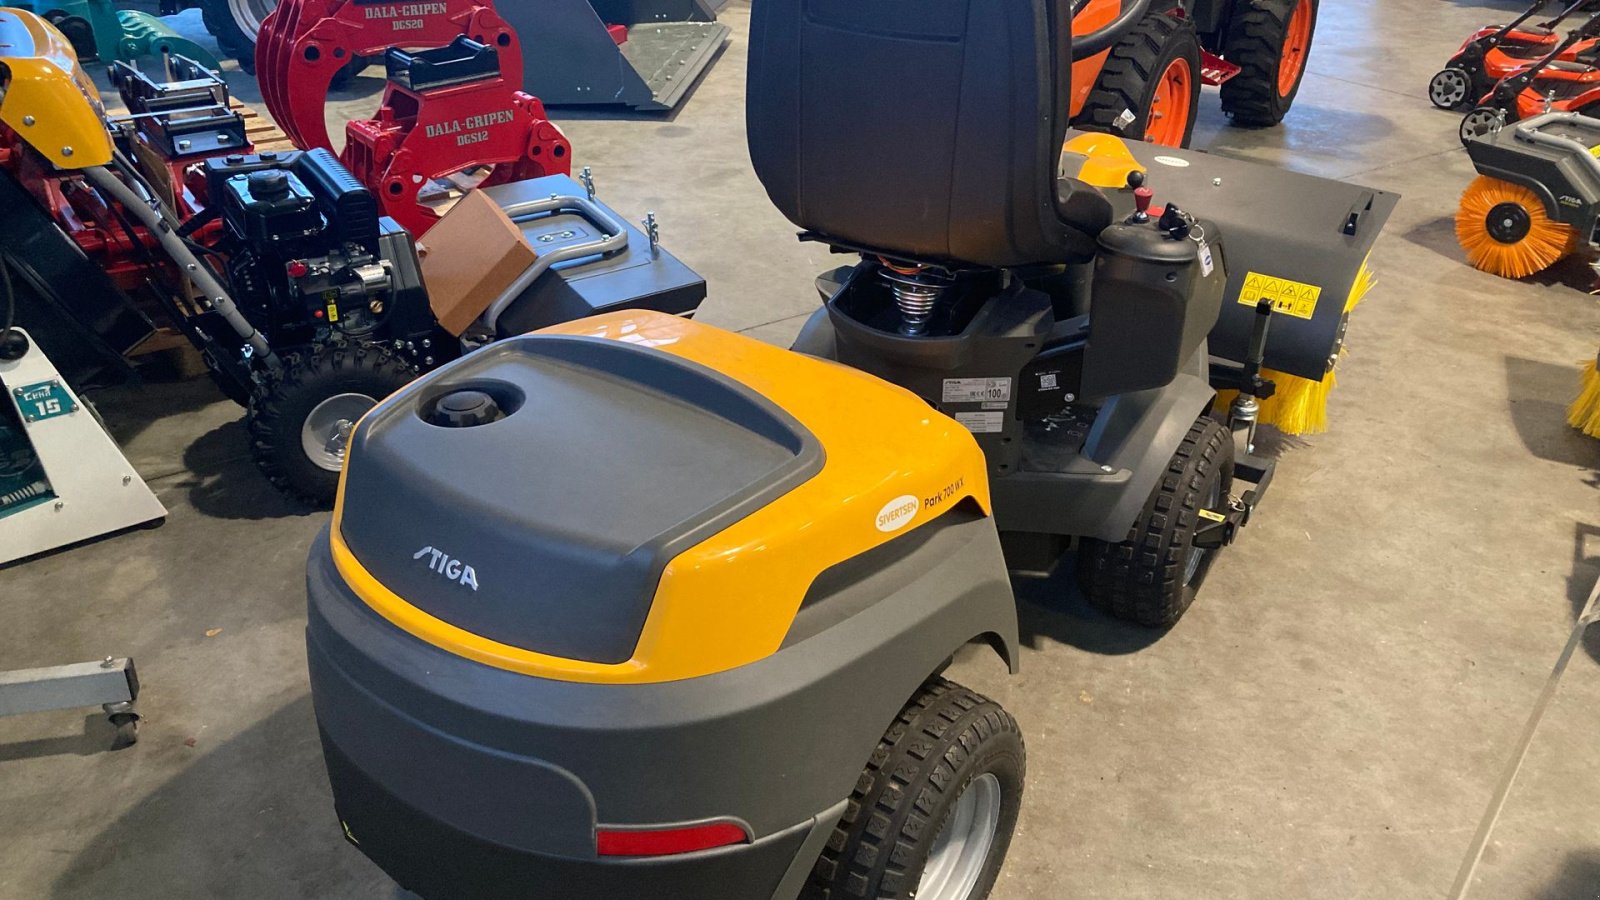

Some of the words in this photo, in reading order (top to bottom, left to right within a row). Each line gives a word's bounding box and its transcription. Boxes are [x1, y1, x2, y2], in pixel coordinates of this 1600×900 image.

[365, 3, 447, 19] DALA-GRIPEN
[392, 19, 424, 31] DGS20
[425, 110, 514, 138] DALA-GRIPEN
[457, 131, 489, 146] DGS12
[988, 388, 1002, 399] 100
[35, 398, 61, 416] 15
[924, 492, 943, 510] Park
[943, 483, 954, 500] 700
[878, 500, 917, 527] SIVERTSEN
[413, 546, 479, 591] STIGA
